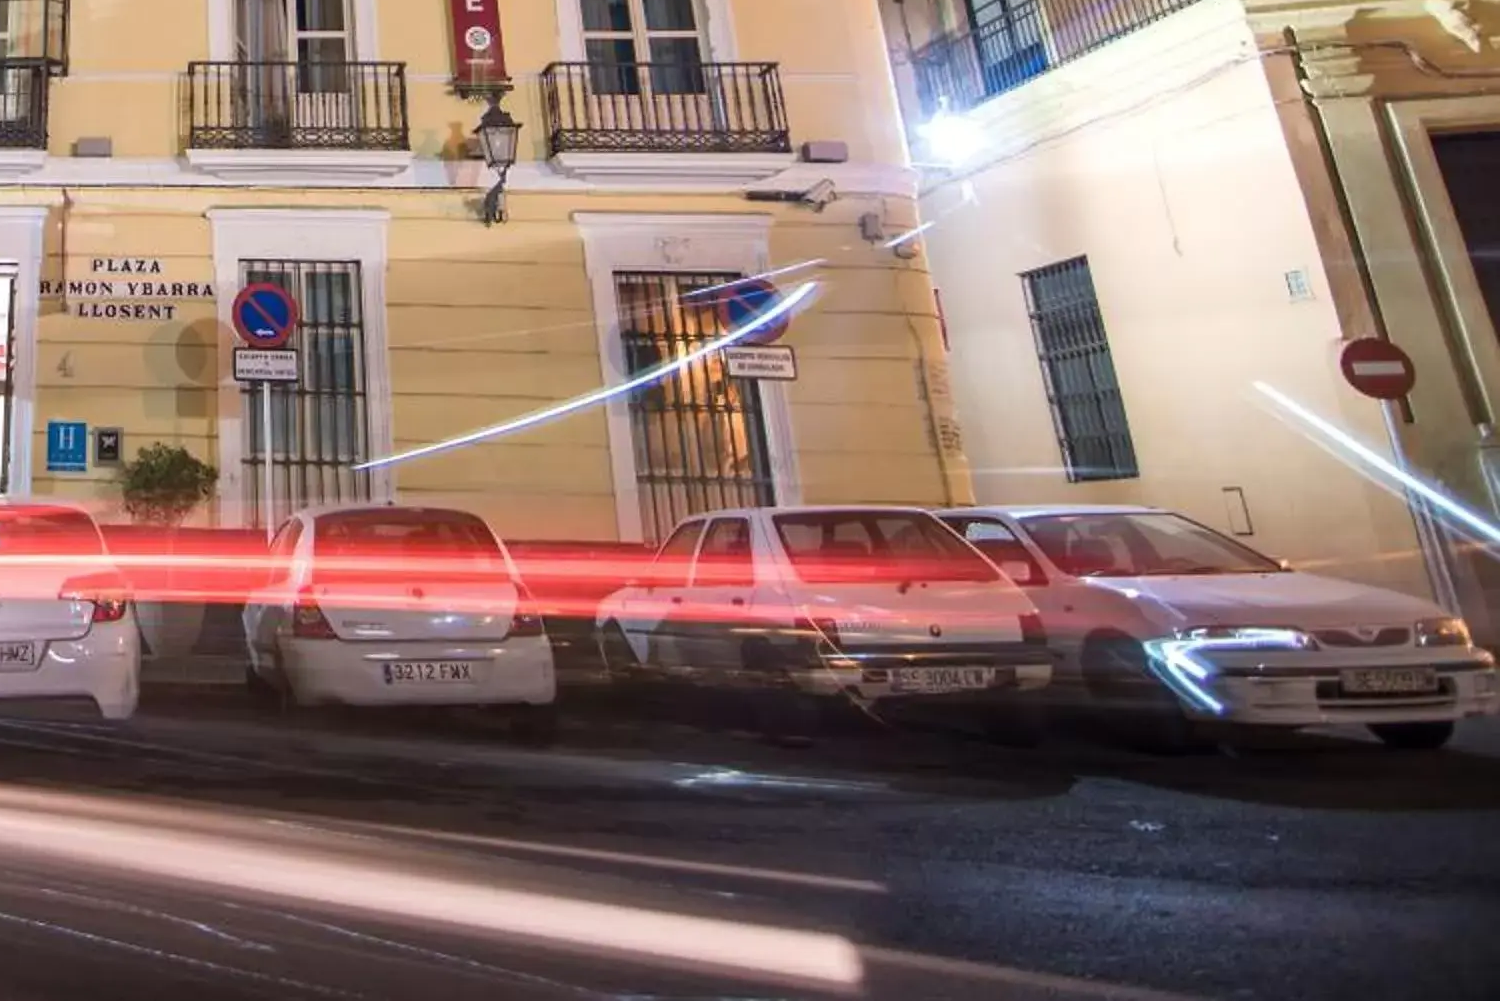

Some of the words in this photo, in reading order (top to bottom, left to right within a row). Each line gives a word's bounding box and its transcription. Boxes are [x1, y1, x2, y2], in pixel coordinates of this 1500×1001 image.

[92, 258, 162, 273] PLAZA
[40, 280, 114, 296] RAMON
[127, 281, 214, 297] YBARRA
[77, 303, 176, 319] LLOSENT
[58, 425, 74, 450] H
[394, 663, 435, 681] 3212
